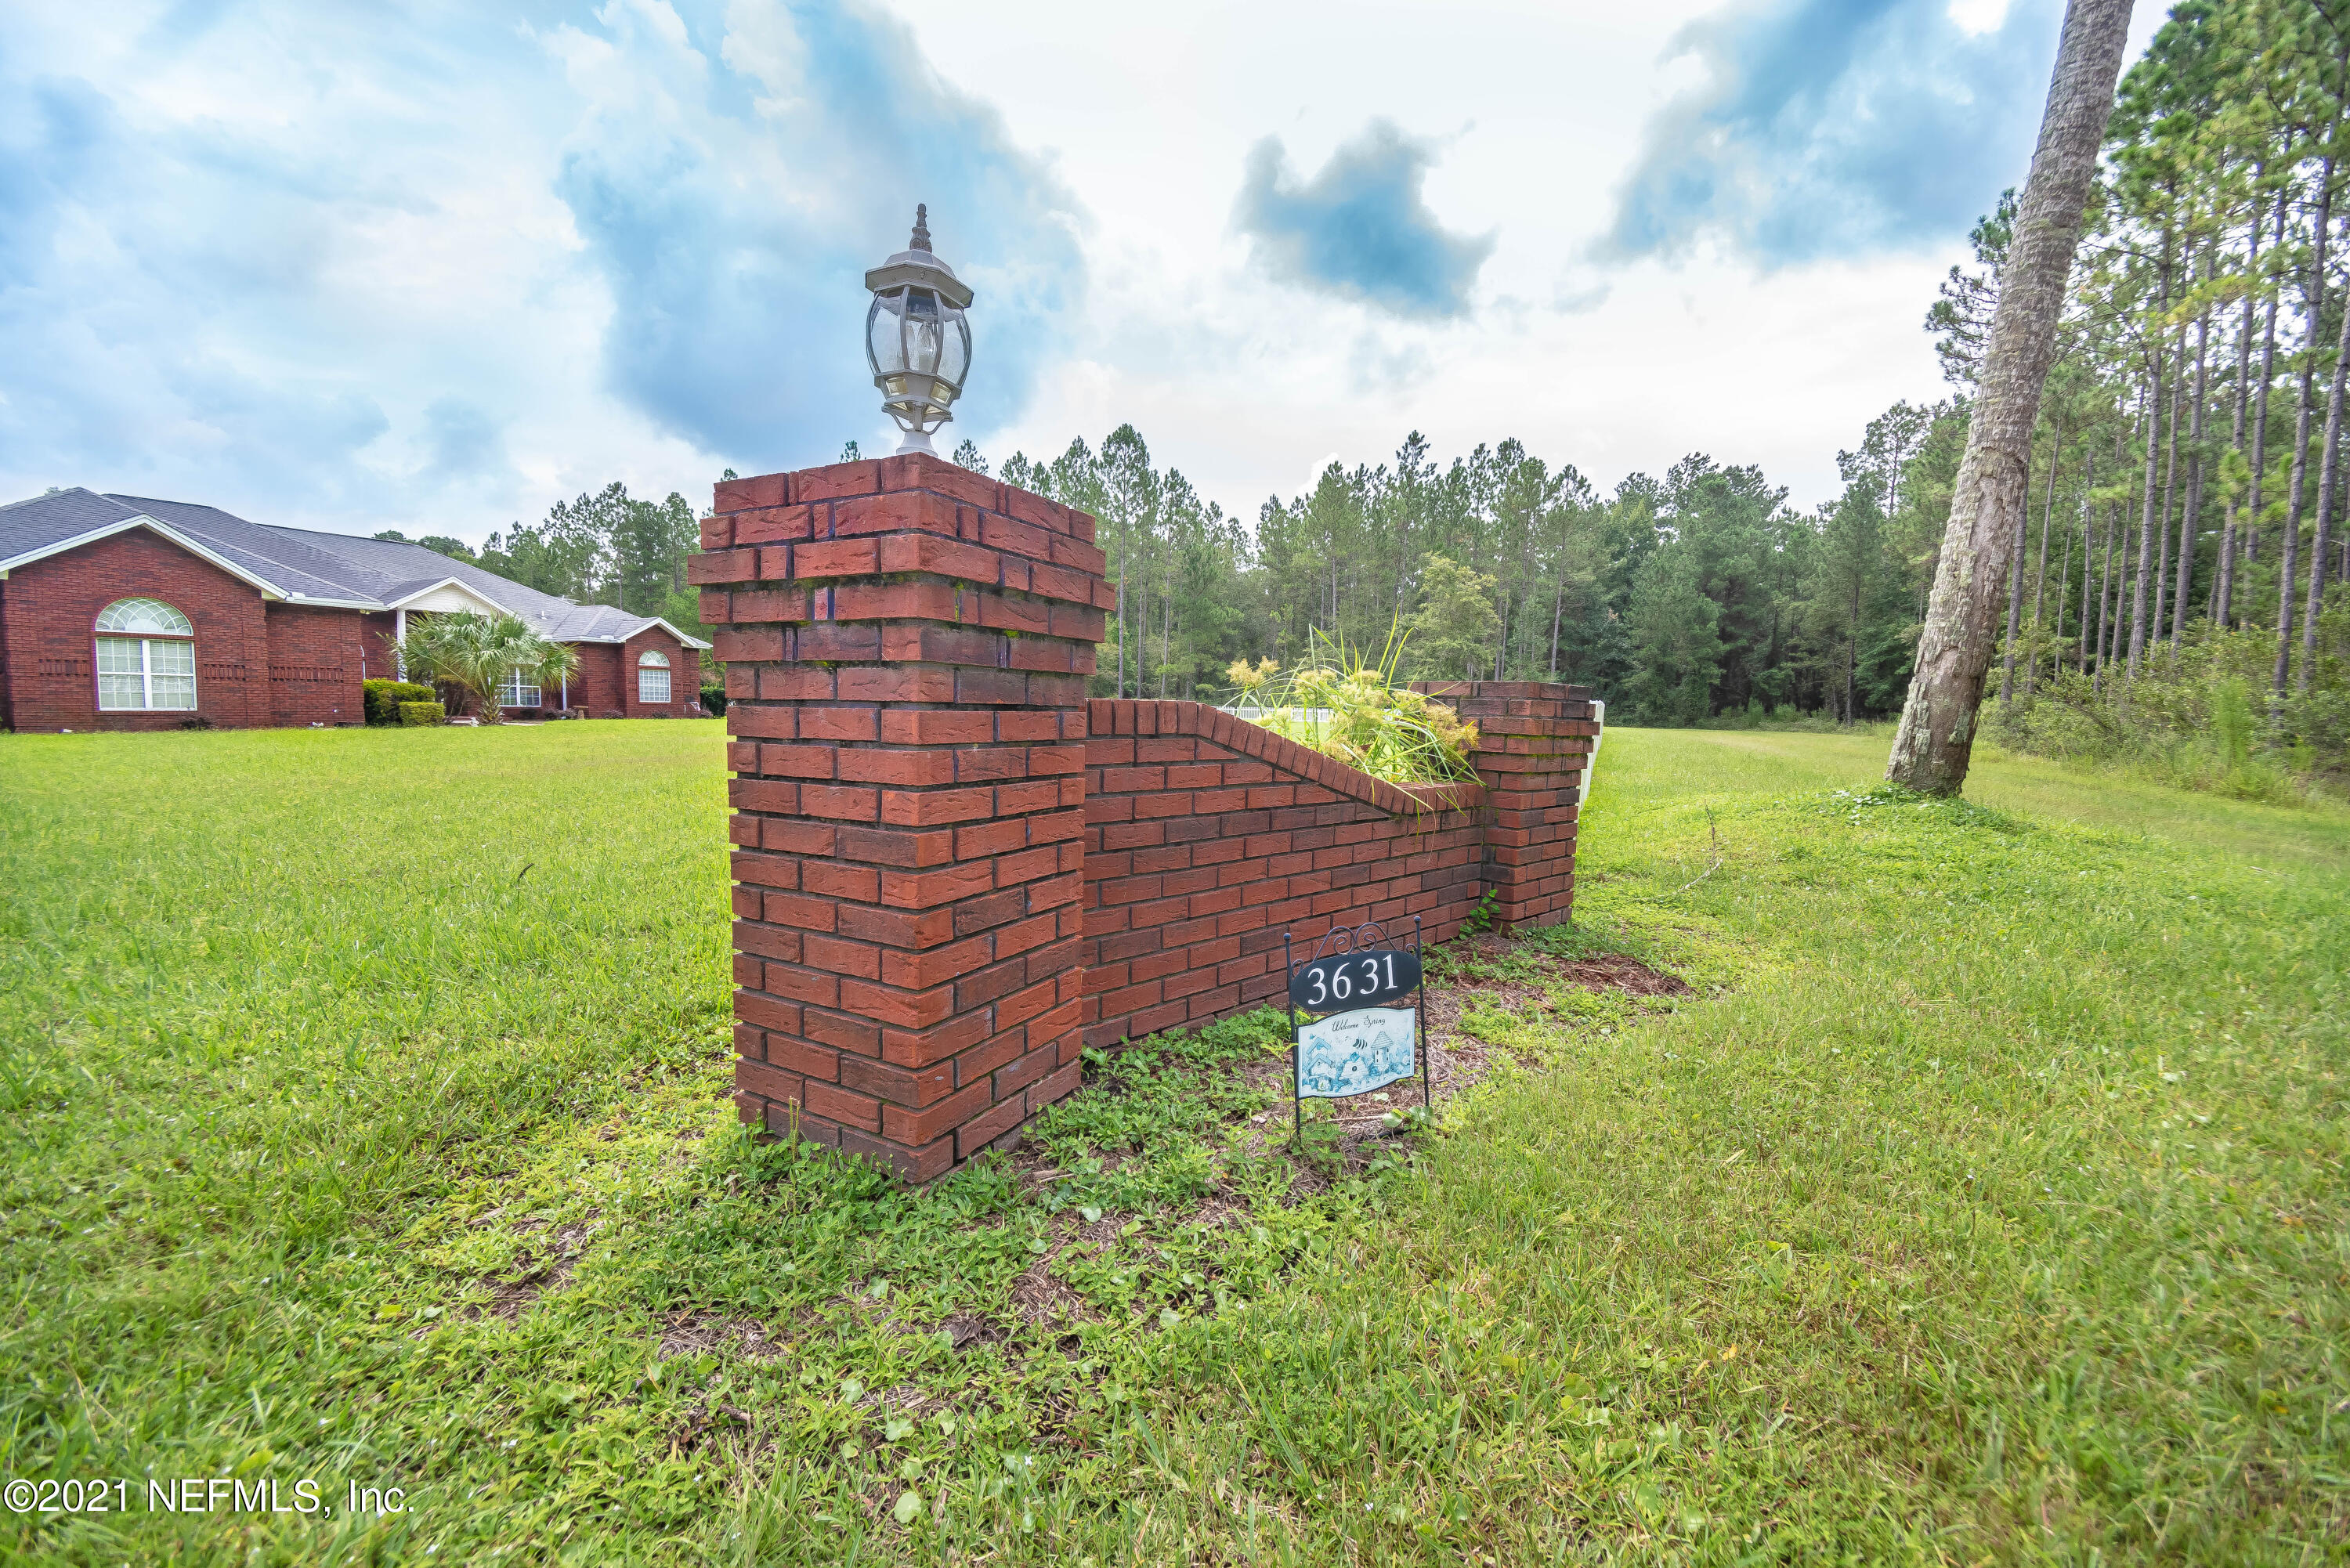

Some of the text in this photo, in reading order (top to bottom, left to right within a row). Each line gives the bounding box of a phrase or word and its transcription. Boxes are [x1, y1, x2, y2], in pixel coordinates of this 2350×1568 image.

[1307, 954, 1398, 1005] 3631
[1332, 1015, 1386, 1032] Welcome Spring
